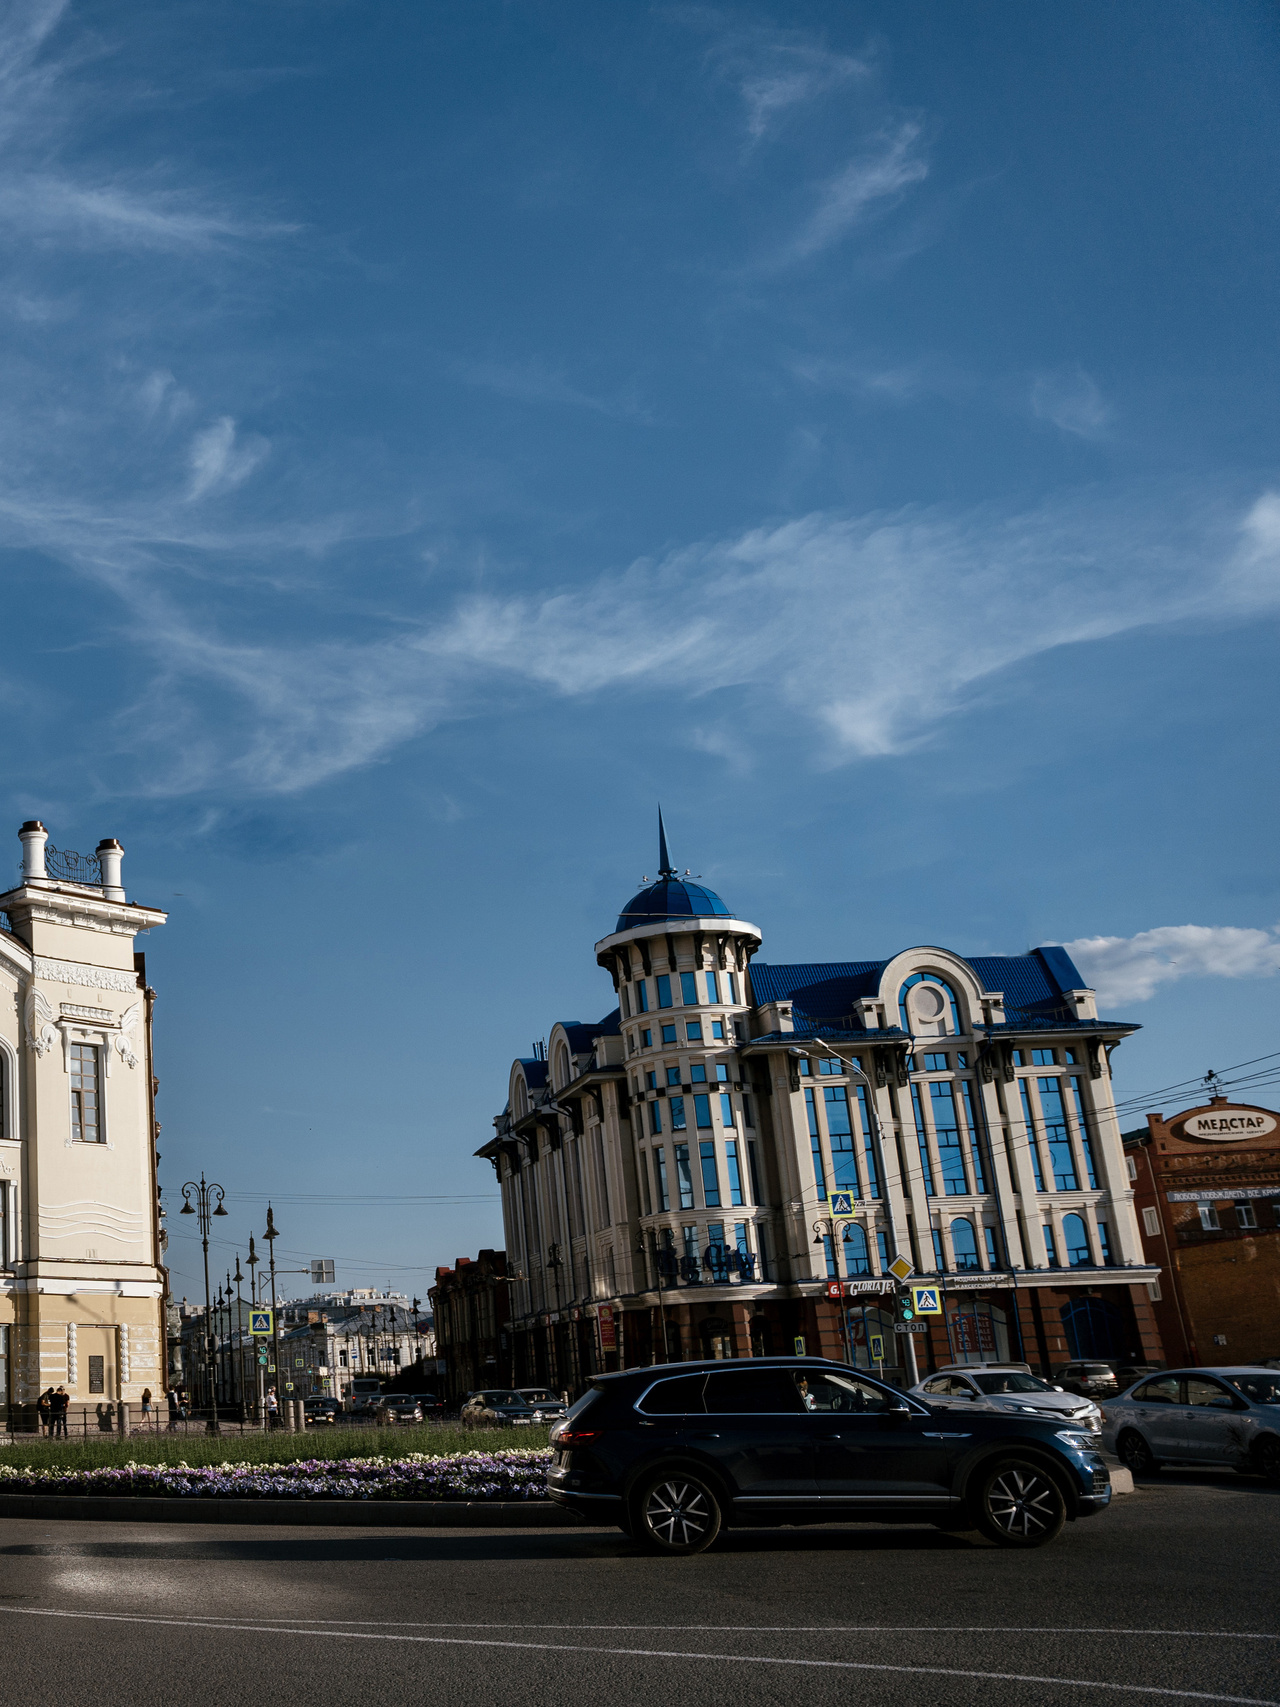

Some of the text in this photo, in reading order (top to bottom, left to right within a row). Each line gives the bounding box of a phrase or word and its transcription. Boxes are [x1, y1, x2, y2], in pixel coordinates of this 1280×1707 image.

[1198, 1117, 1264, 1131] МЕДСТАР
[1262, 1187, 1280, 1197] КРОМ
[704, 1243, 756, 1279] City
[850, 1281, 880, 1296] GLORIA
[895, 1323, 925, 1332] СТОП
